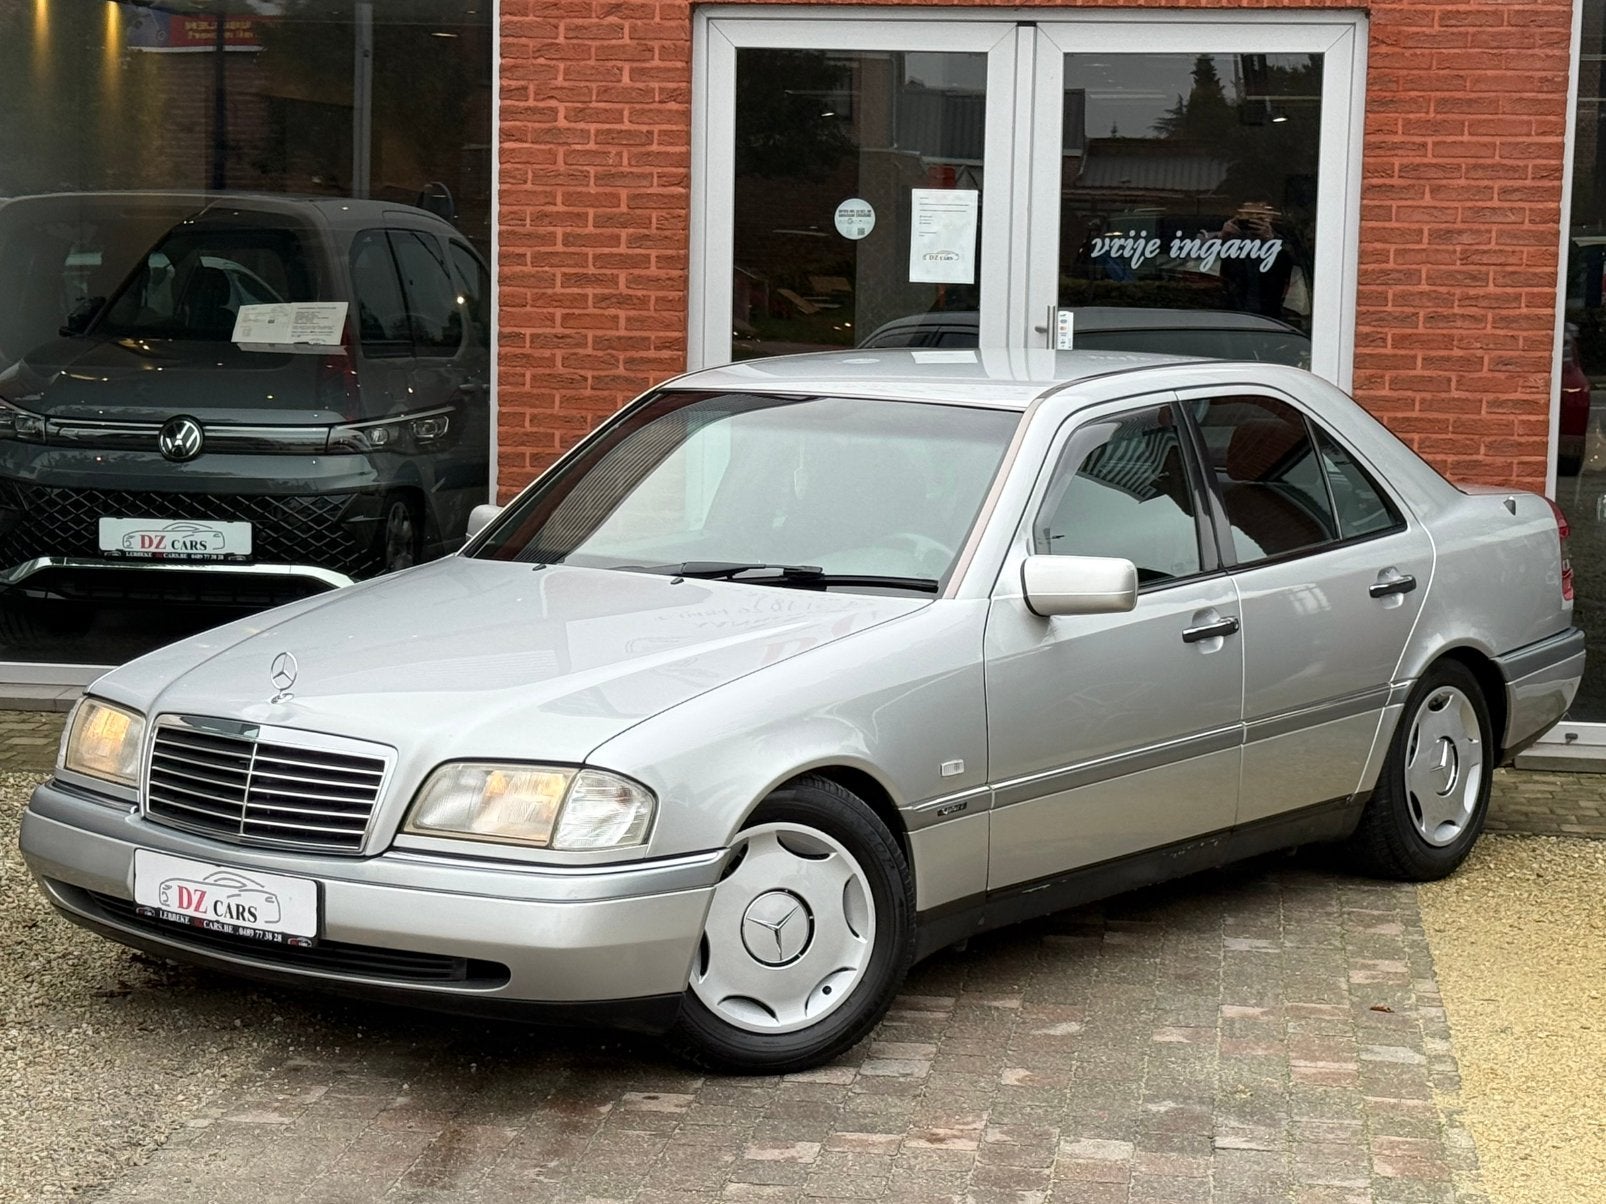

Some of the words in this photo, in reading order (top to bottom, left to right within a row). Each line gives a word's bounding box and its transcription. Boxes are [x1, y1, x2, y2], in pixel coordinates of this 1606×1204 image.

[1090, 230, 1161, 270] vrije
[1169, 230, 1283, 273] ingang
[139, 534, 167, 550] DZ
[171, 539, 208, 551] CARS
[177, 885, 208, 914] DZ
[213, 900, 258, 924] CARS
[255, 929, 263, 939] 77
